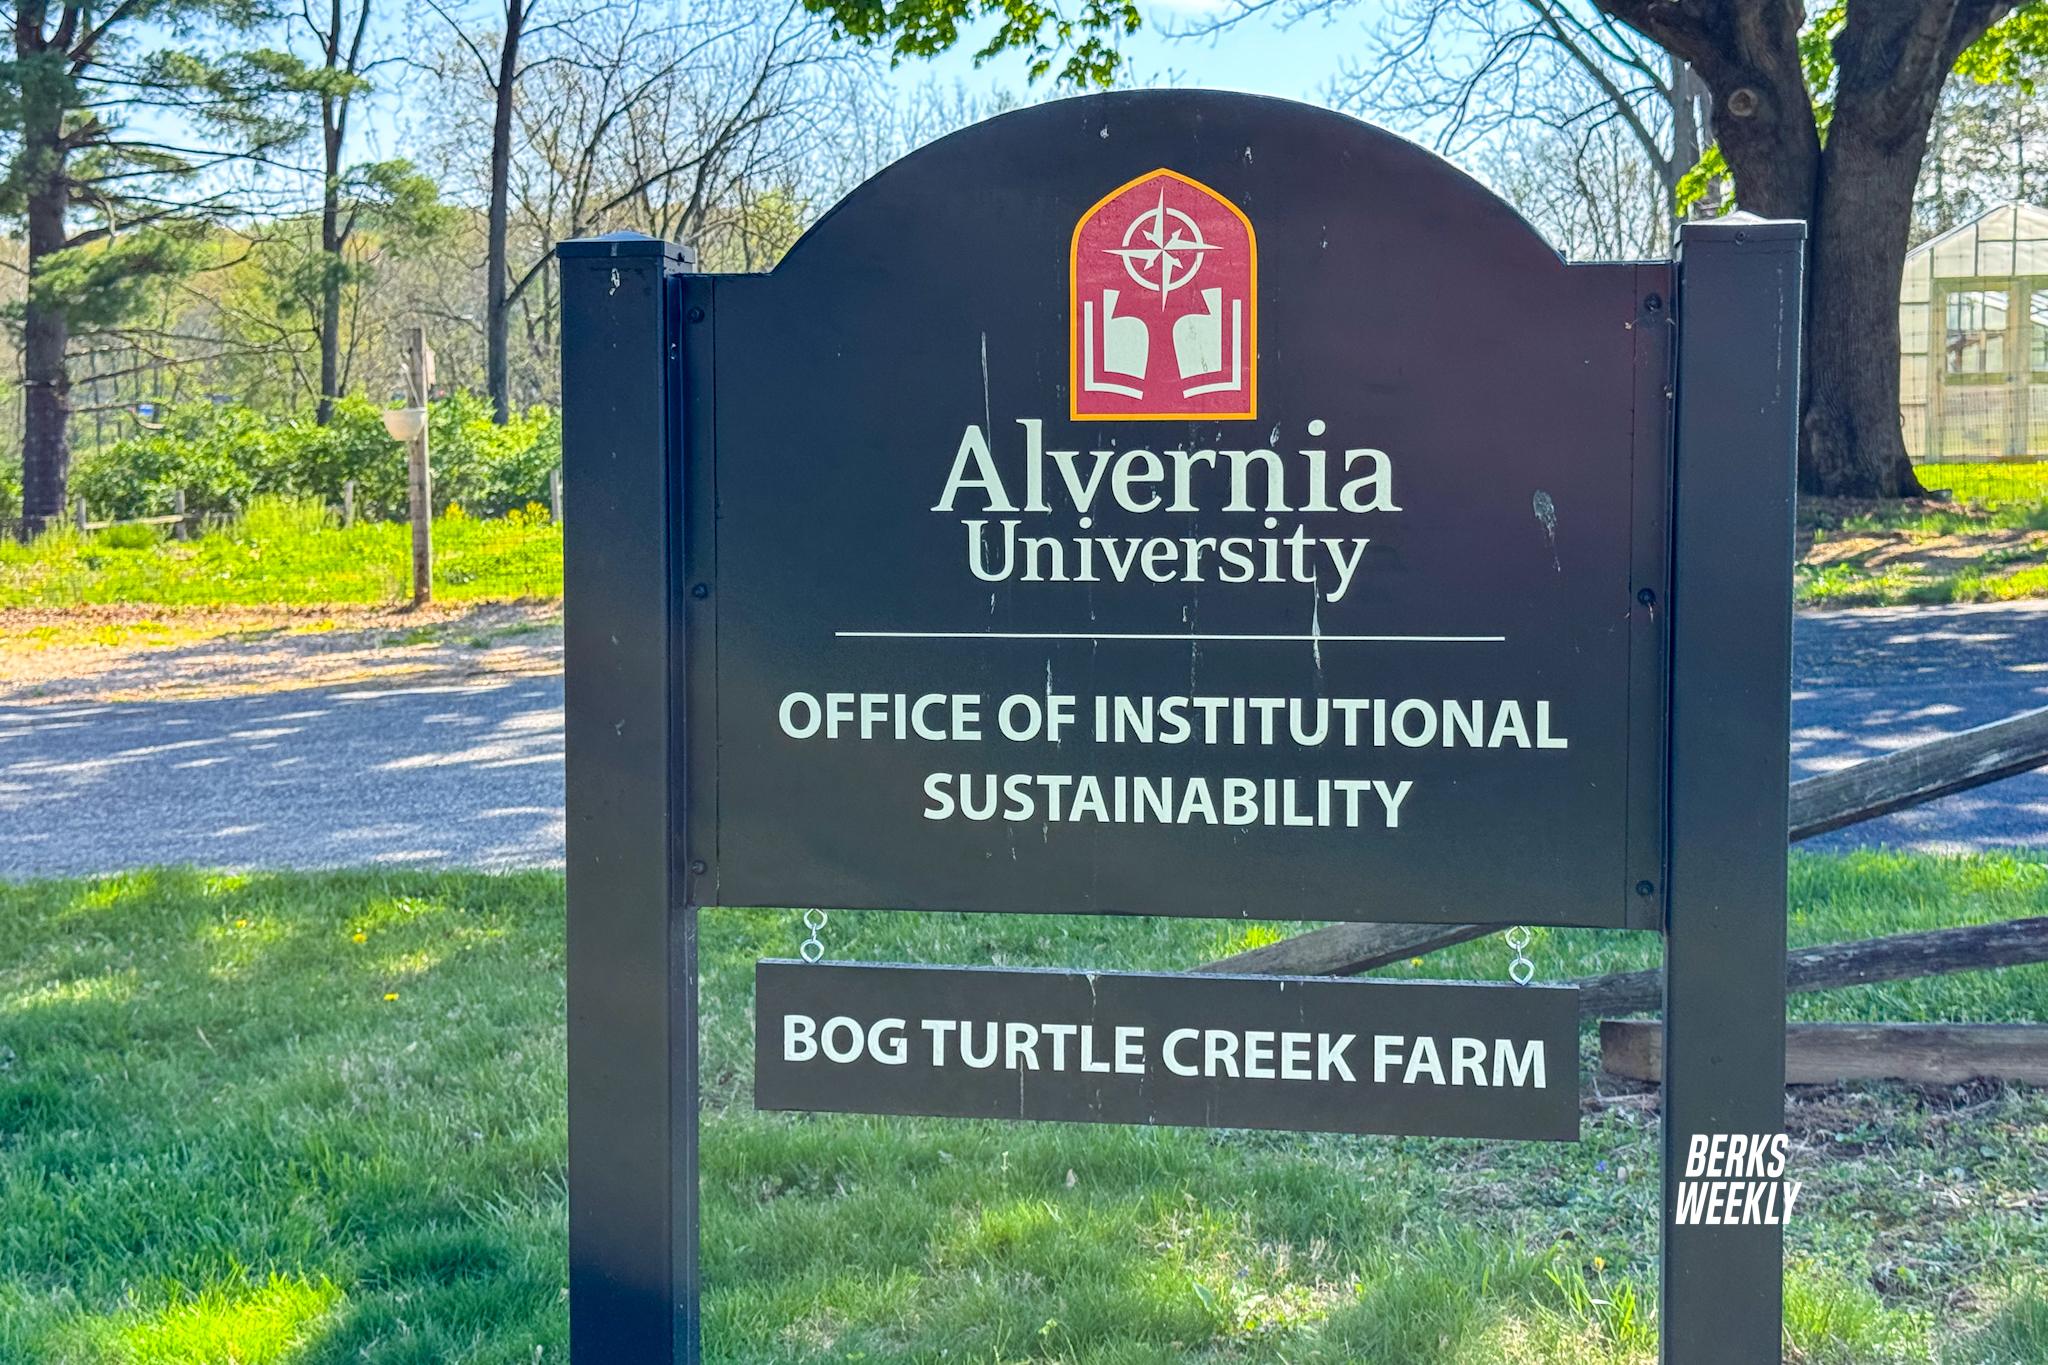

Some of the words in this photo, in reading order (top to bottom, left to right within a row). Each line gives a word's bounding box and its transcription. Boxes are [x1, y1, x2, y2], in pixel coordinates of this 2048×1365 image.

[931, 419, 1402, 512] Alvernia
[962, 517, 1370, 602] University
[779, 692, 981, 740] OFFICE
[999, 695, 1075, 743] OF
[1096, 696, 1567, 748] INSTITUTIONAL
[924, 773, 1413, 827] SUSTAINABILITY
[784, 1015, 907, 1064] BOG
[922, 1020, 1145, 1074] TURTLE
[1163, 1029, 1356, 1081] CREEK
[1374, 1036, 1546, 1088] FARM
